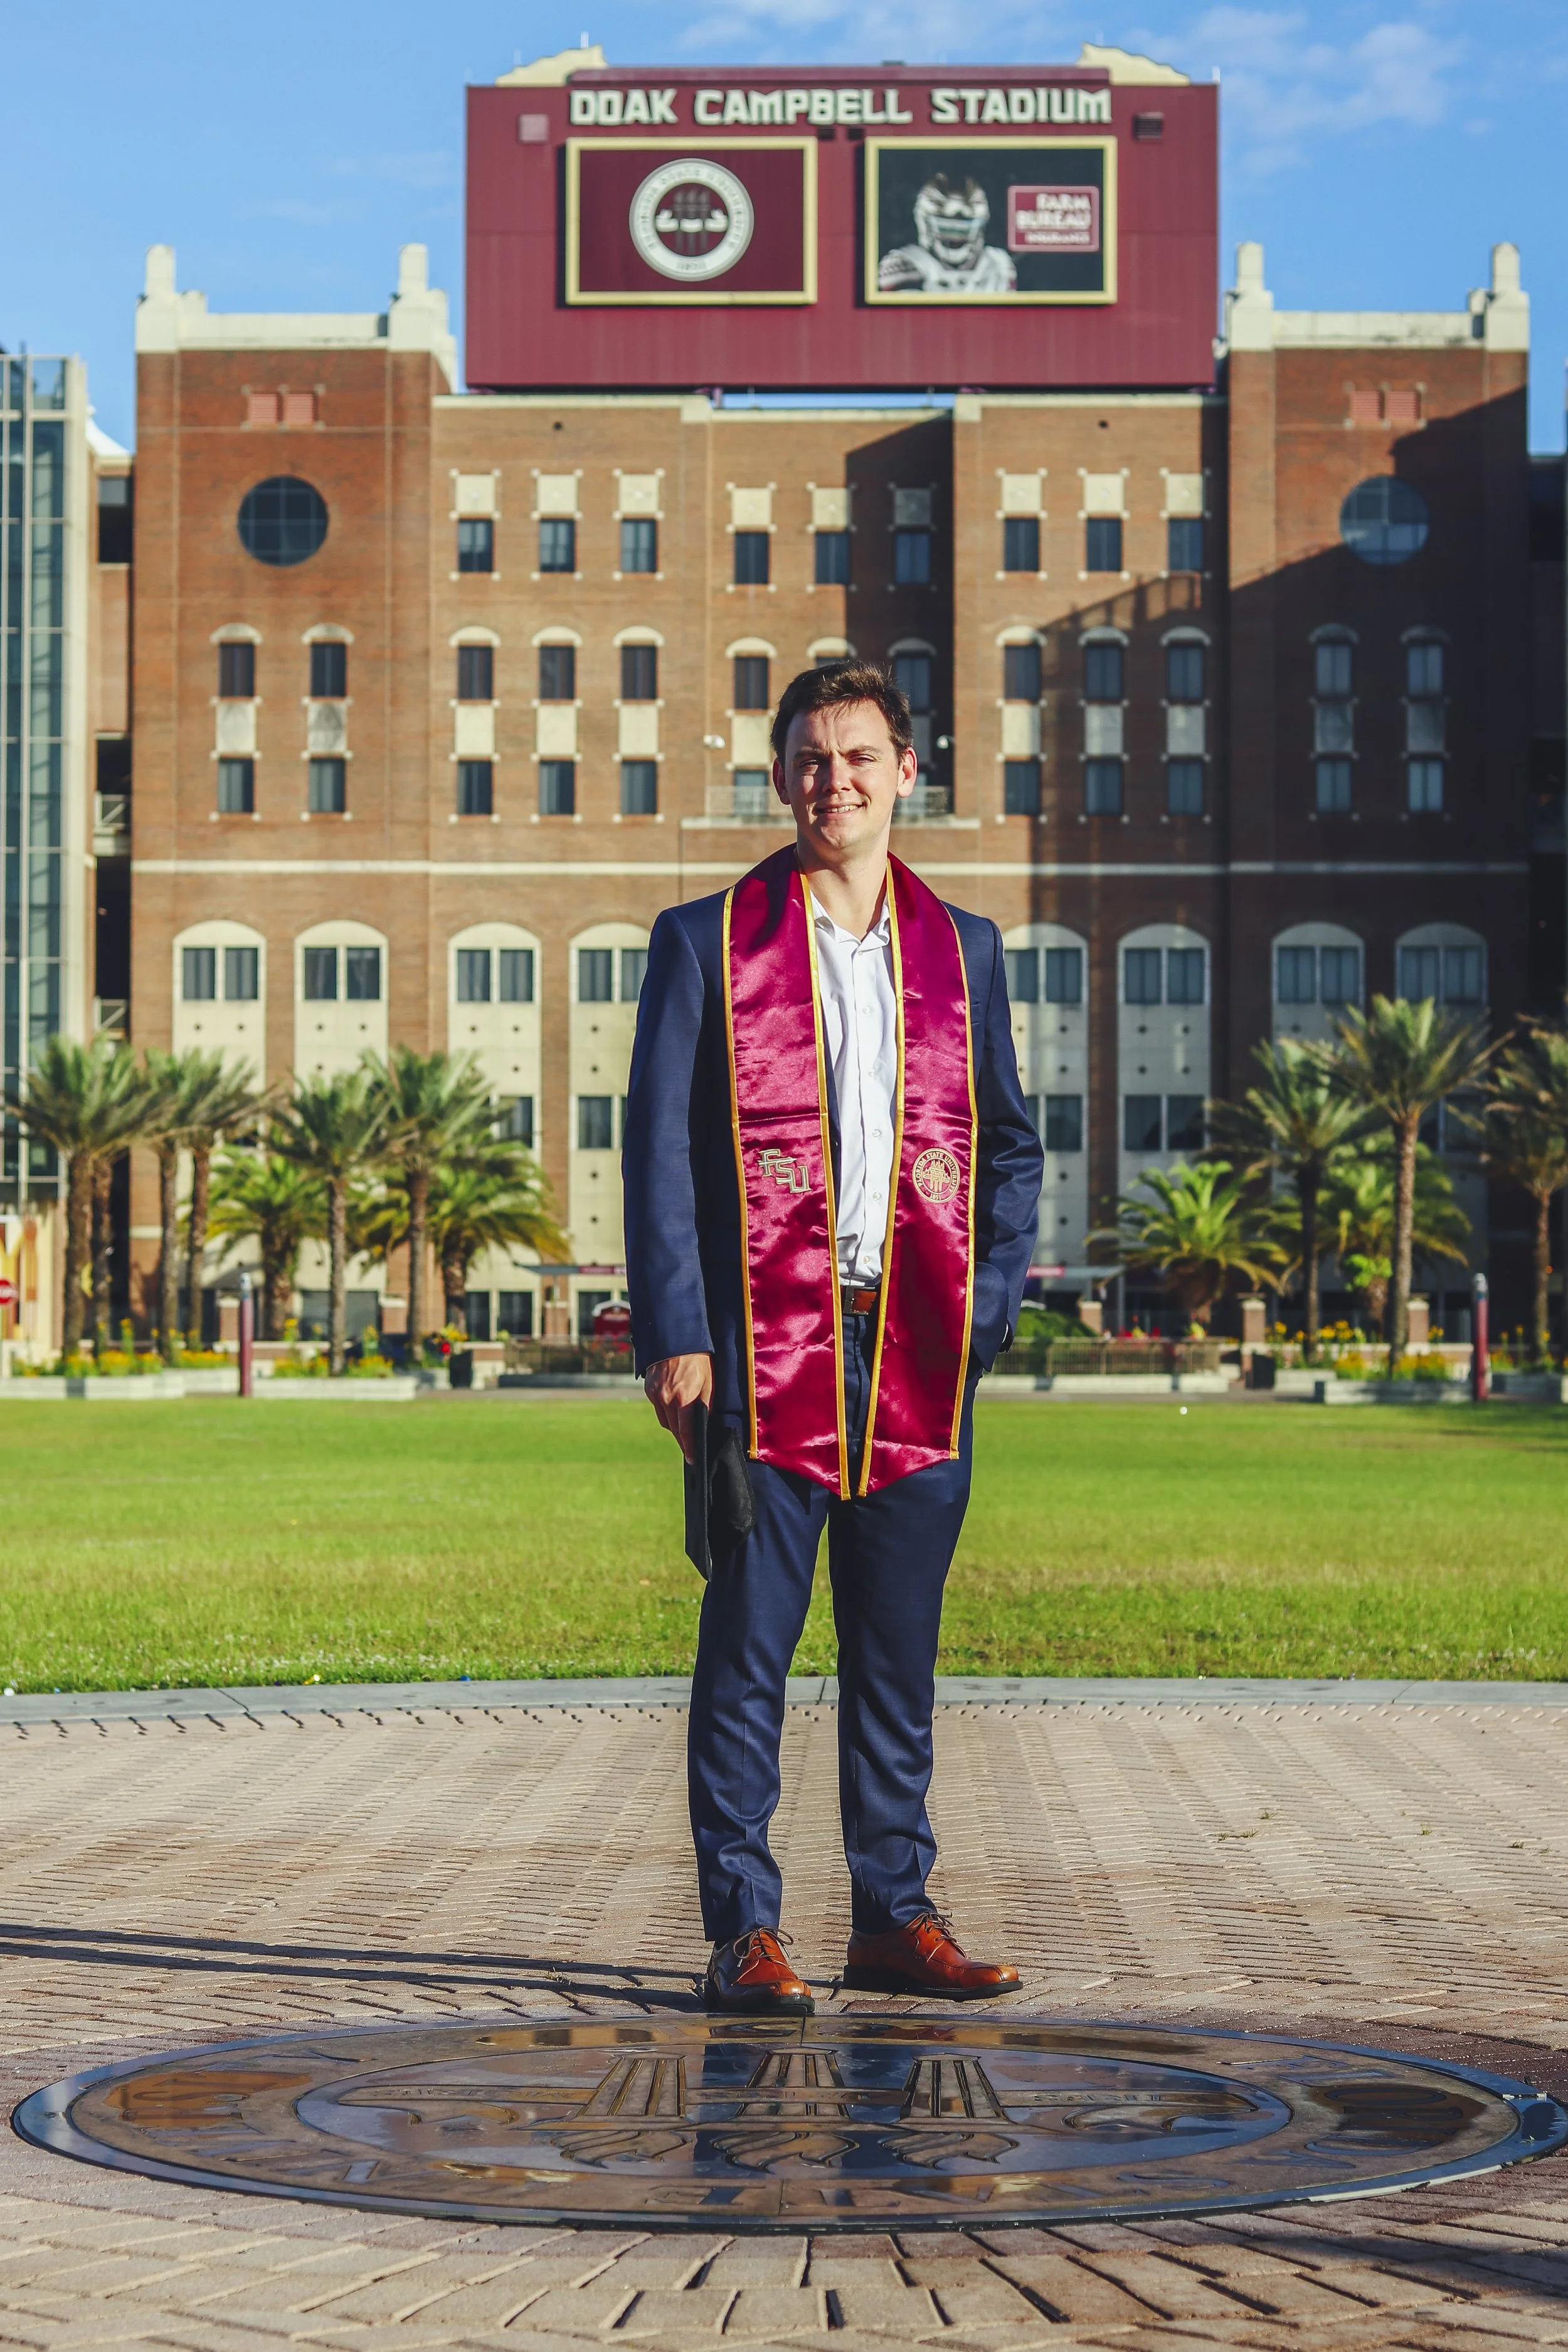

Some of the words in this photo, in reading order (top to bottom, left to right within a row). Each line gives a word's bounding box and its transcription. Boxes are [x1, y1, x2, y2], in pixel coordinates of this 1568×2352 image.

[570, 88, 678, 125] DOAK
[694, 88, 913, 125] CAMPBELL
[931, 88, 1112, 124] STADIUM
[757, 1148, 813, 1194] FSU
[915, 1158, 926, 1187] FLORIDA
[944, 1155, 957, 1194] UNIVERSITY
[643, 2170, 1232, 2208] STATE
